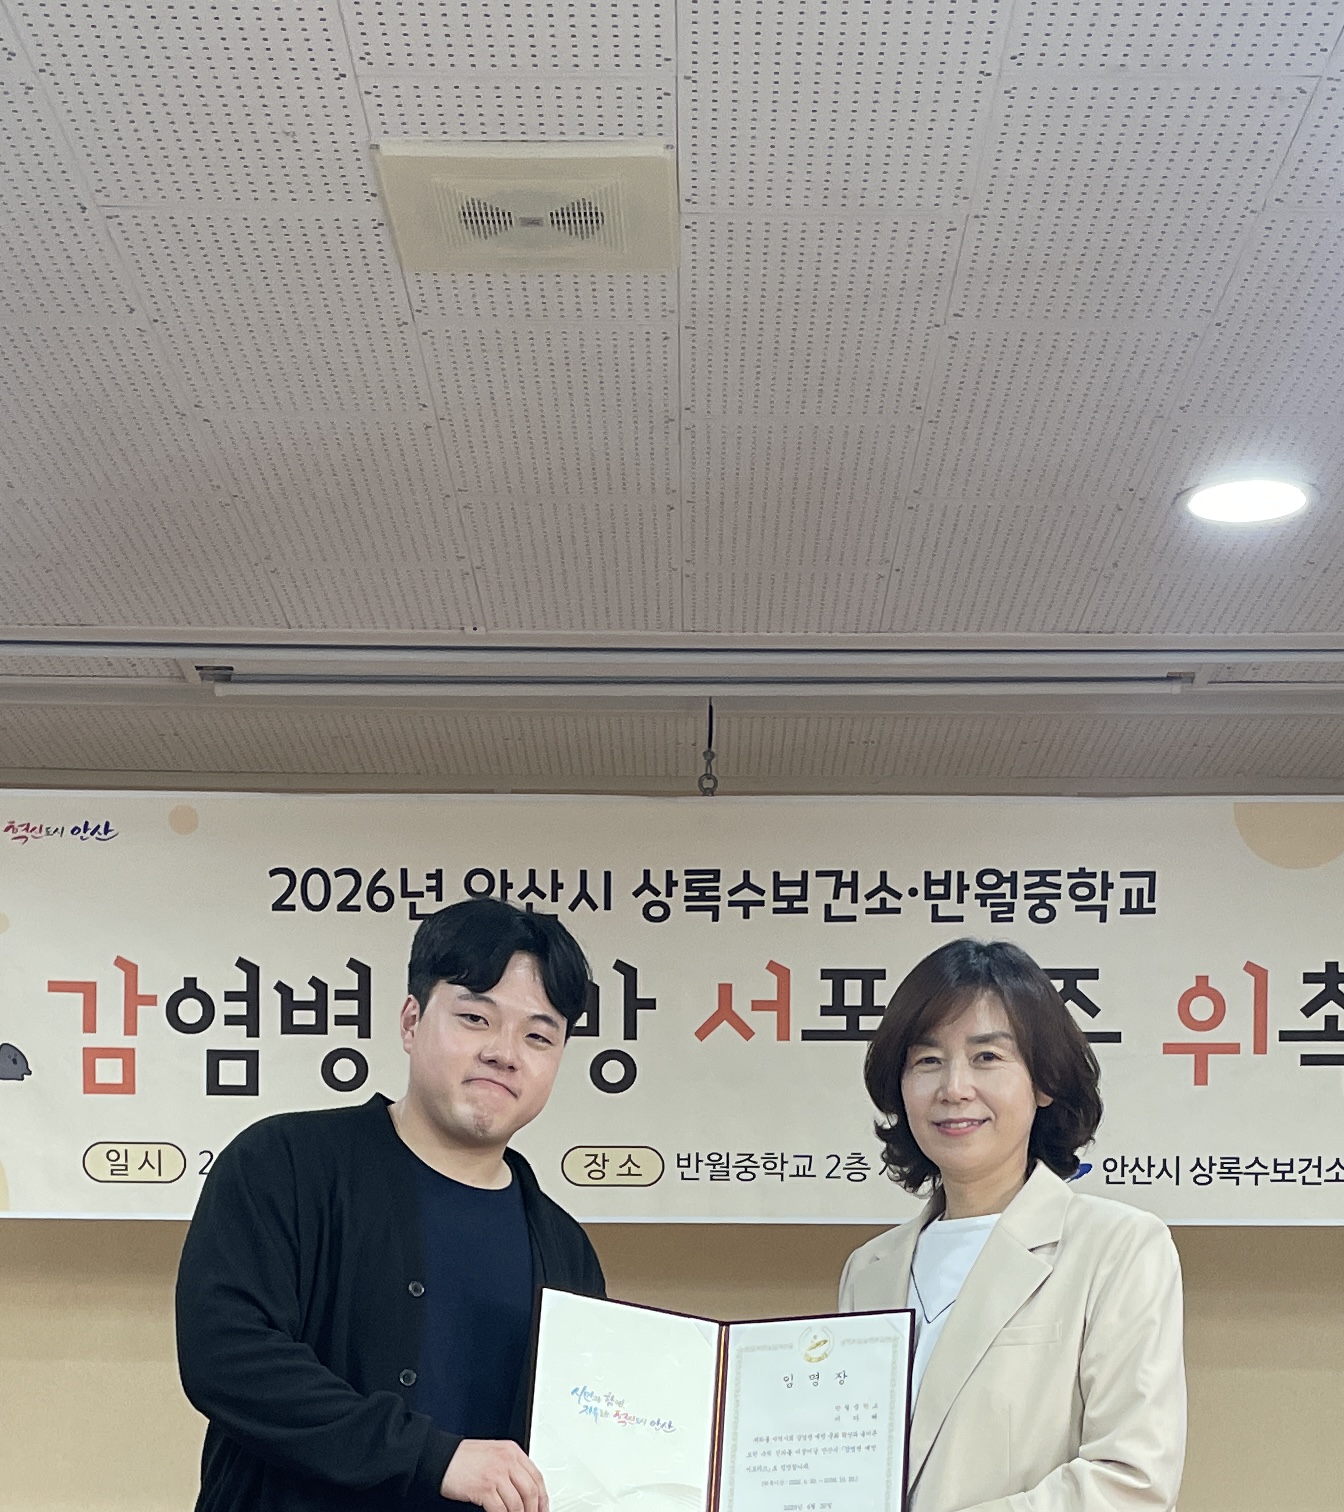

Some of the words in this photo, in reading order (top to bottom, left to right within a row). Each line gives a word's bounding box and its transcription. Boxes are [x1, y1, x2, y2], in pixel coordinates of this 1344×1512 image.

[3, 820, 64, 845] 혁신도시
[70, 820, 119, 842] 안산
[268, 867, 444, 921] 2026년
[631, 867, 1157, 923] 상록수보건소·반월중학교
[47, 954, 372, 1096] 감염병
[694, 959, 1123, 1043] 서포즈
[105, 1149, 162, 1177] 일시
[583, 1152, 643, 1181] 장소
[675, 1151, 817, 1182] 반월중학교
[824, 1152, 871, 1182] 2층
[1102, 1156, 1181, 1186] 안산시
